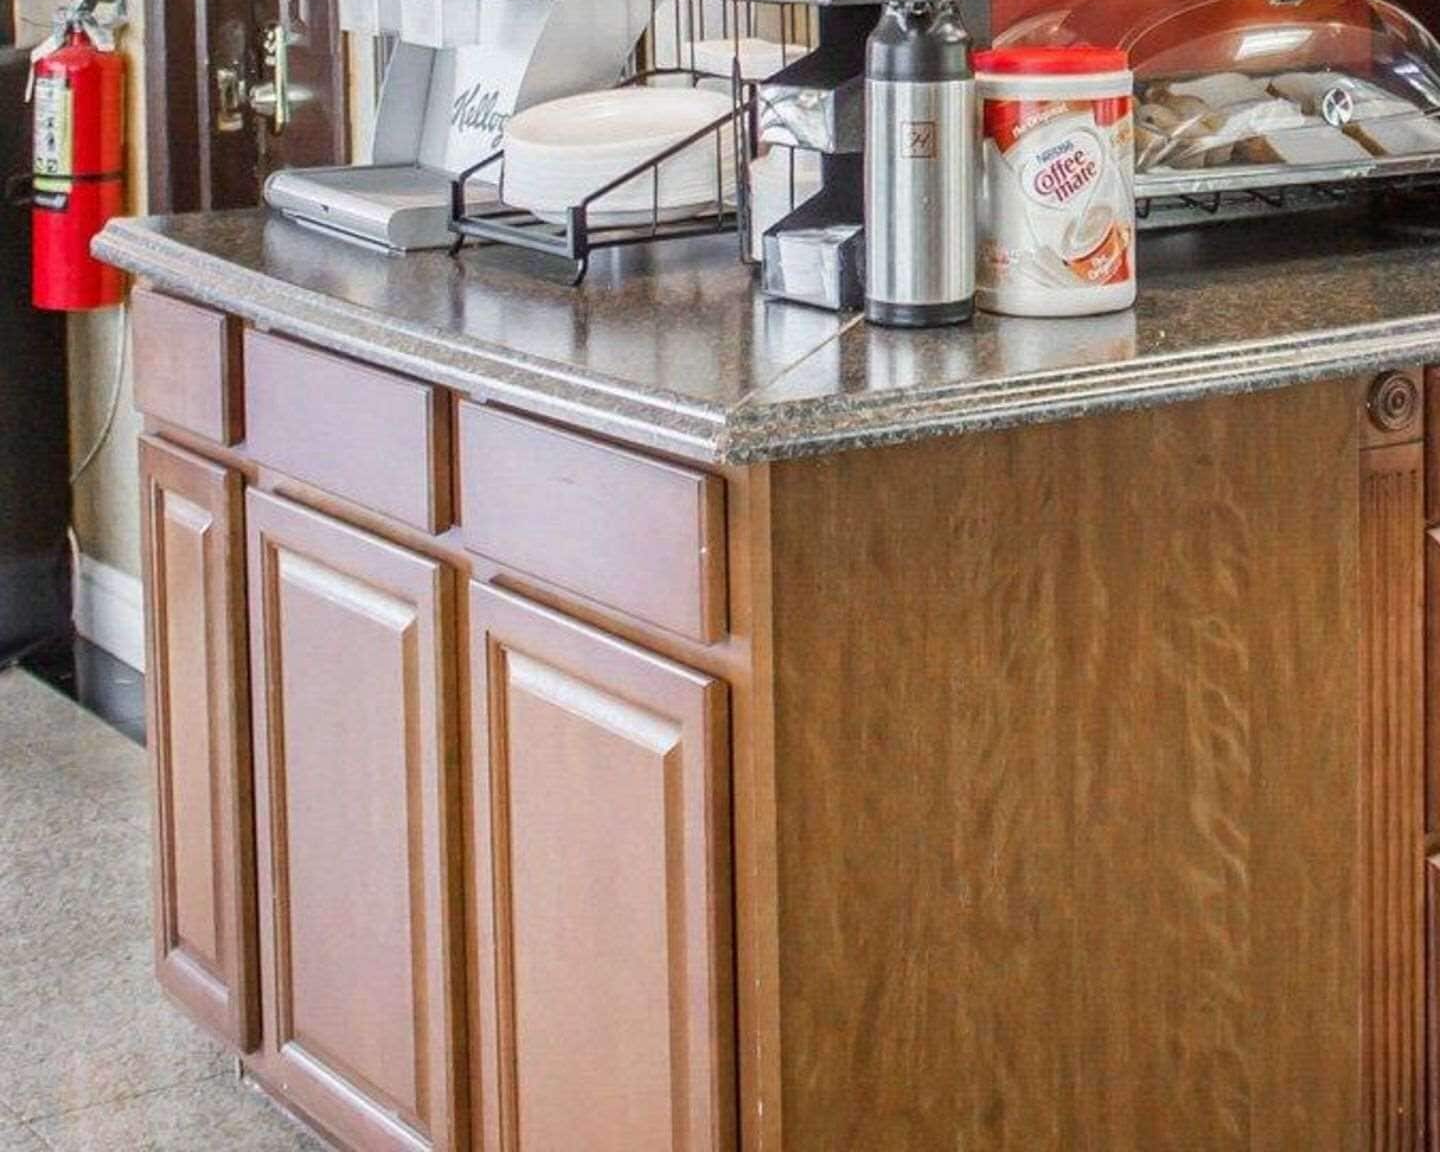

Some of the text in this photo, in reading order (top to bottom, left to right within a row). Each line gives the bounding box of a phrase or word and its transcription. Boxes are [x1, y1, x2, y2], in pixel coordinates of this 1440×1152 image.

[452, 83, 516, 149] Kellog
[1034, 149, 1086, 197] Coffee
[1053, 160, 1098, 203] mate
